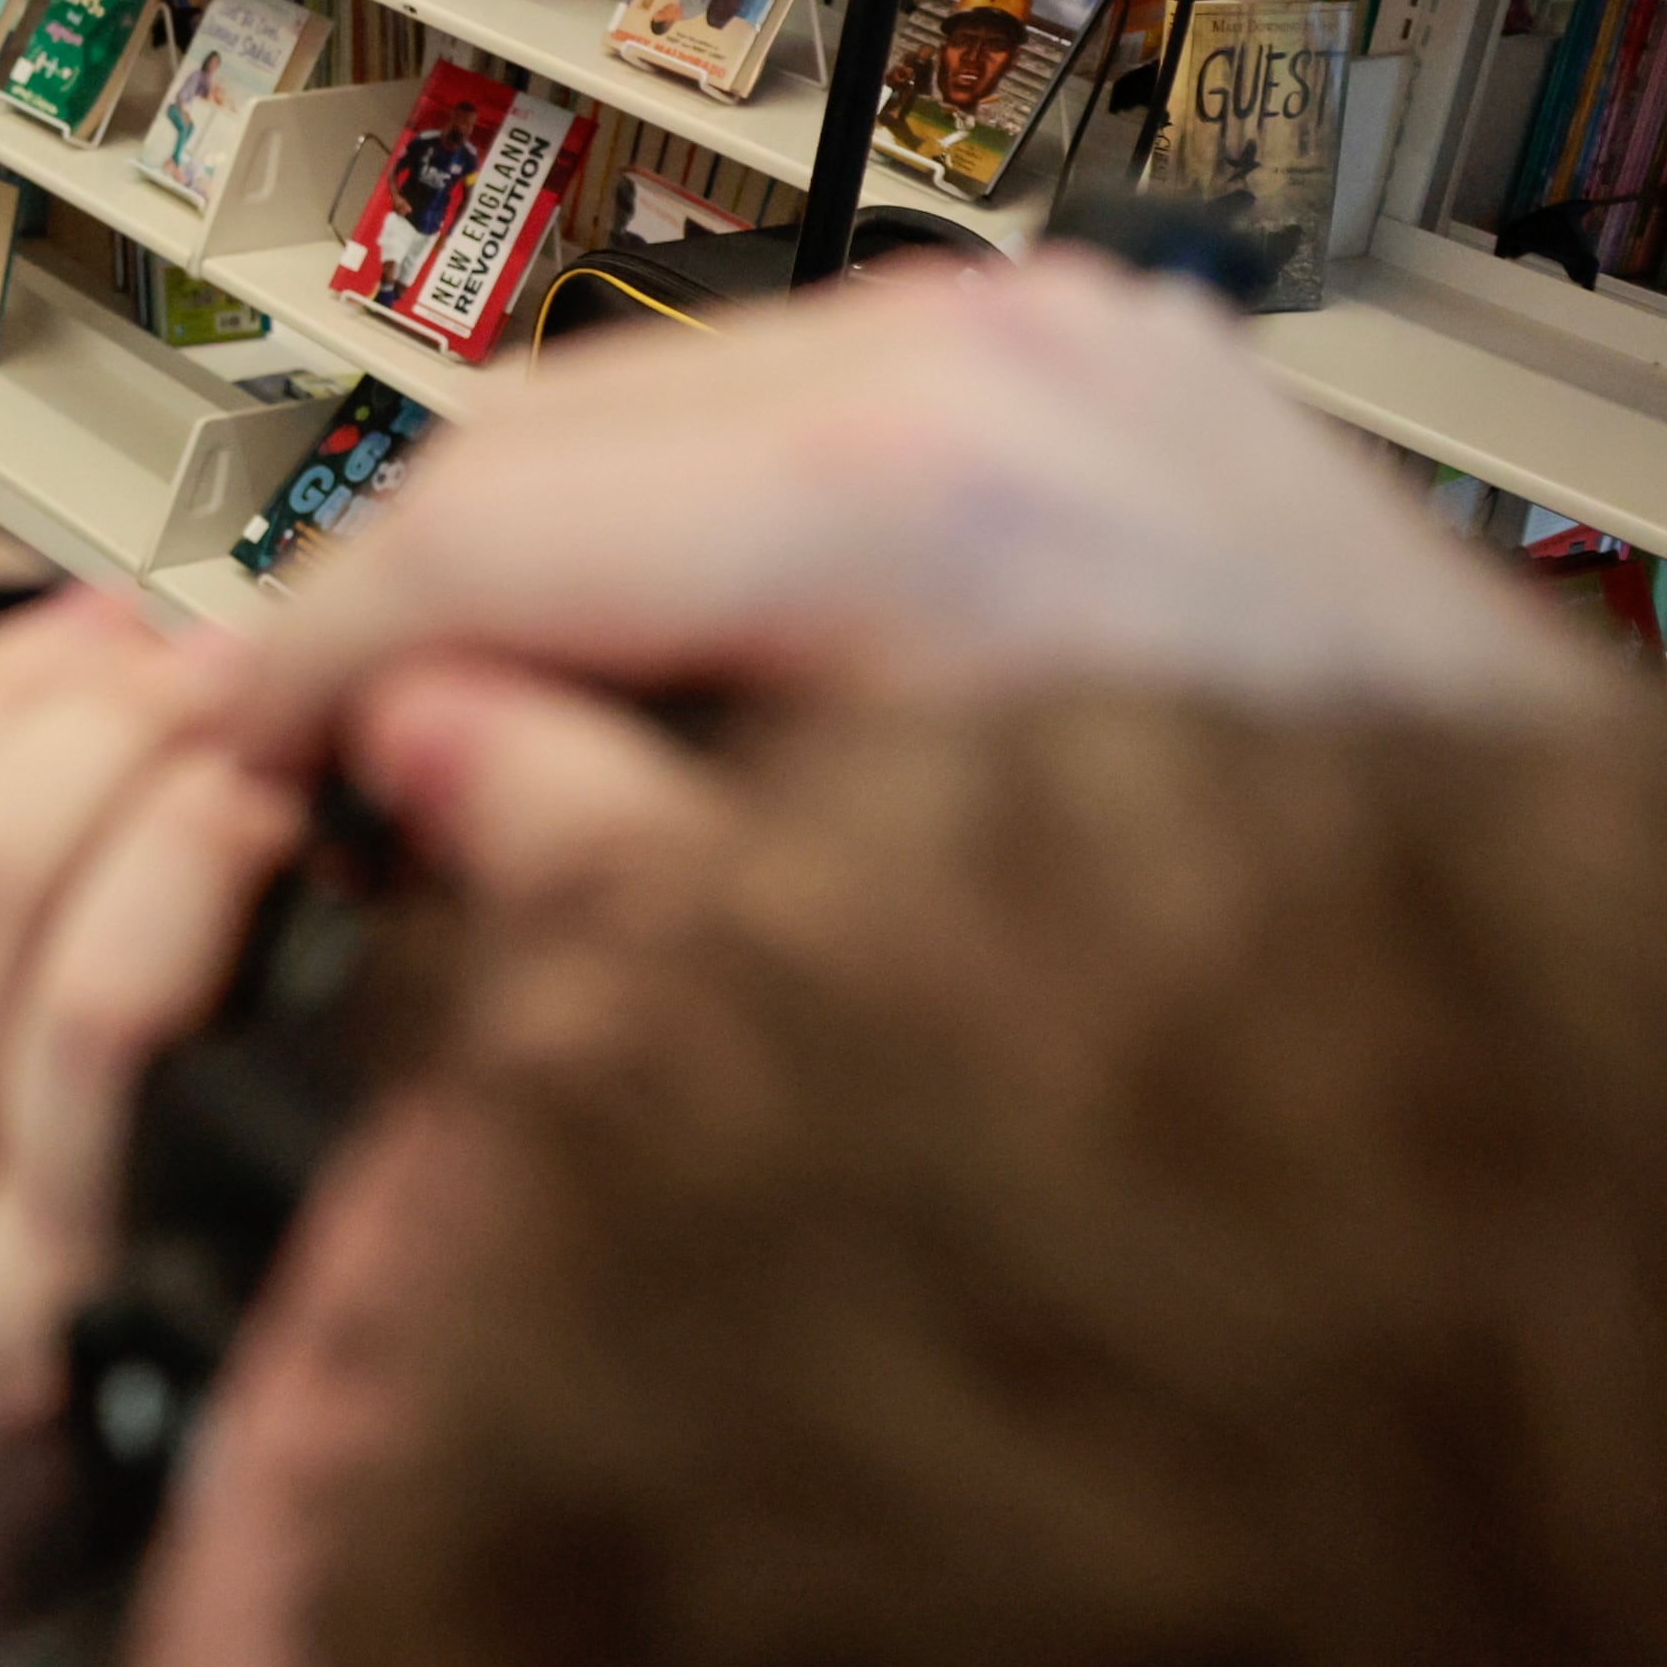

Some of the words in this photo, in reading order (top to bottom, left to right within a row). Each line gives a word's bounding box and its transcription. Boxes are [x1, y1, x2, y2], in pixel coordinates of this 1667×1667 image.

[1195, 40, 1350, 133] GUEST
[431, 248, 473, 306] NEW
[462, 126, 534, 243] ENGLAND
[453, 135, 552, 315] REVOLUTION
